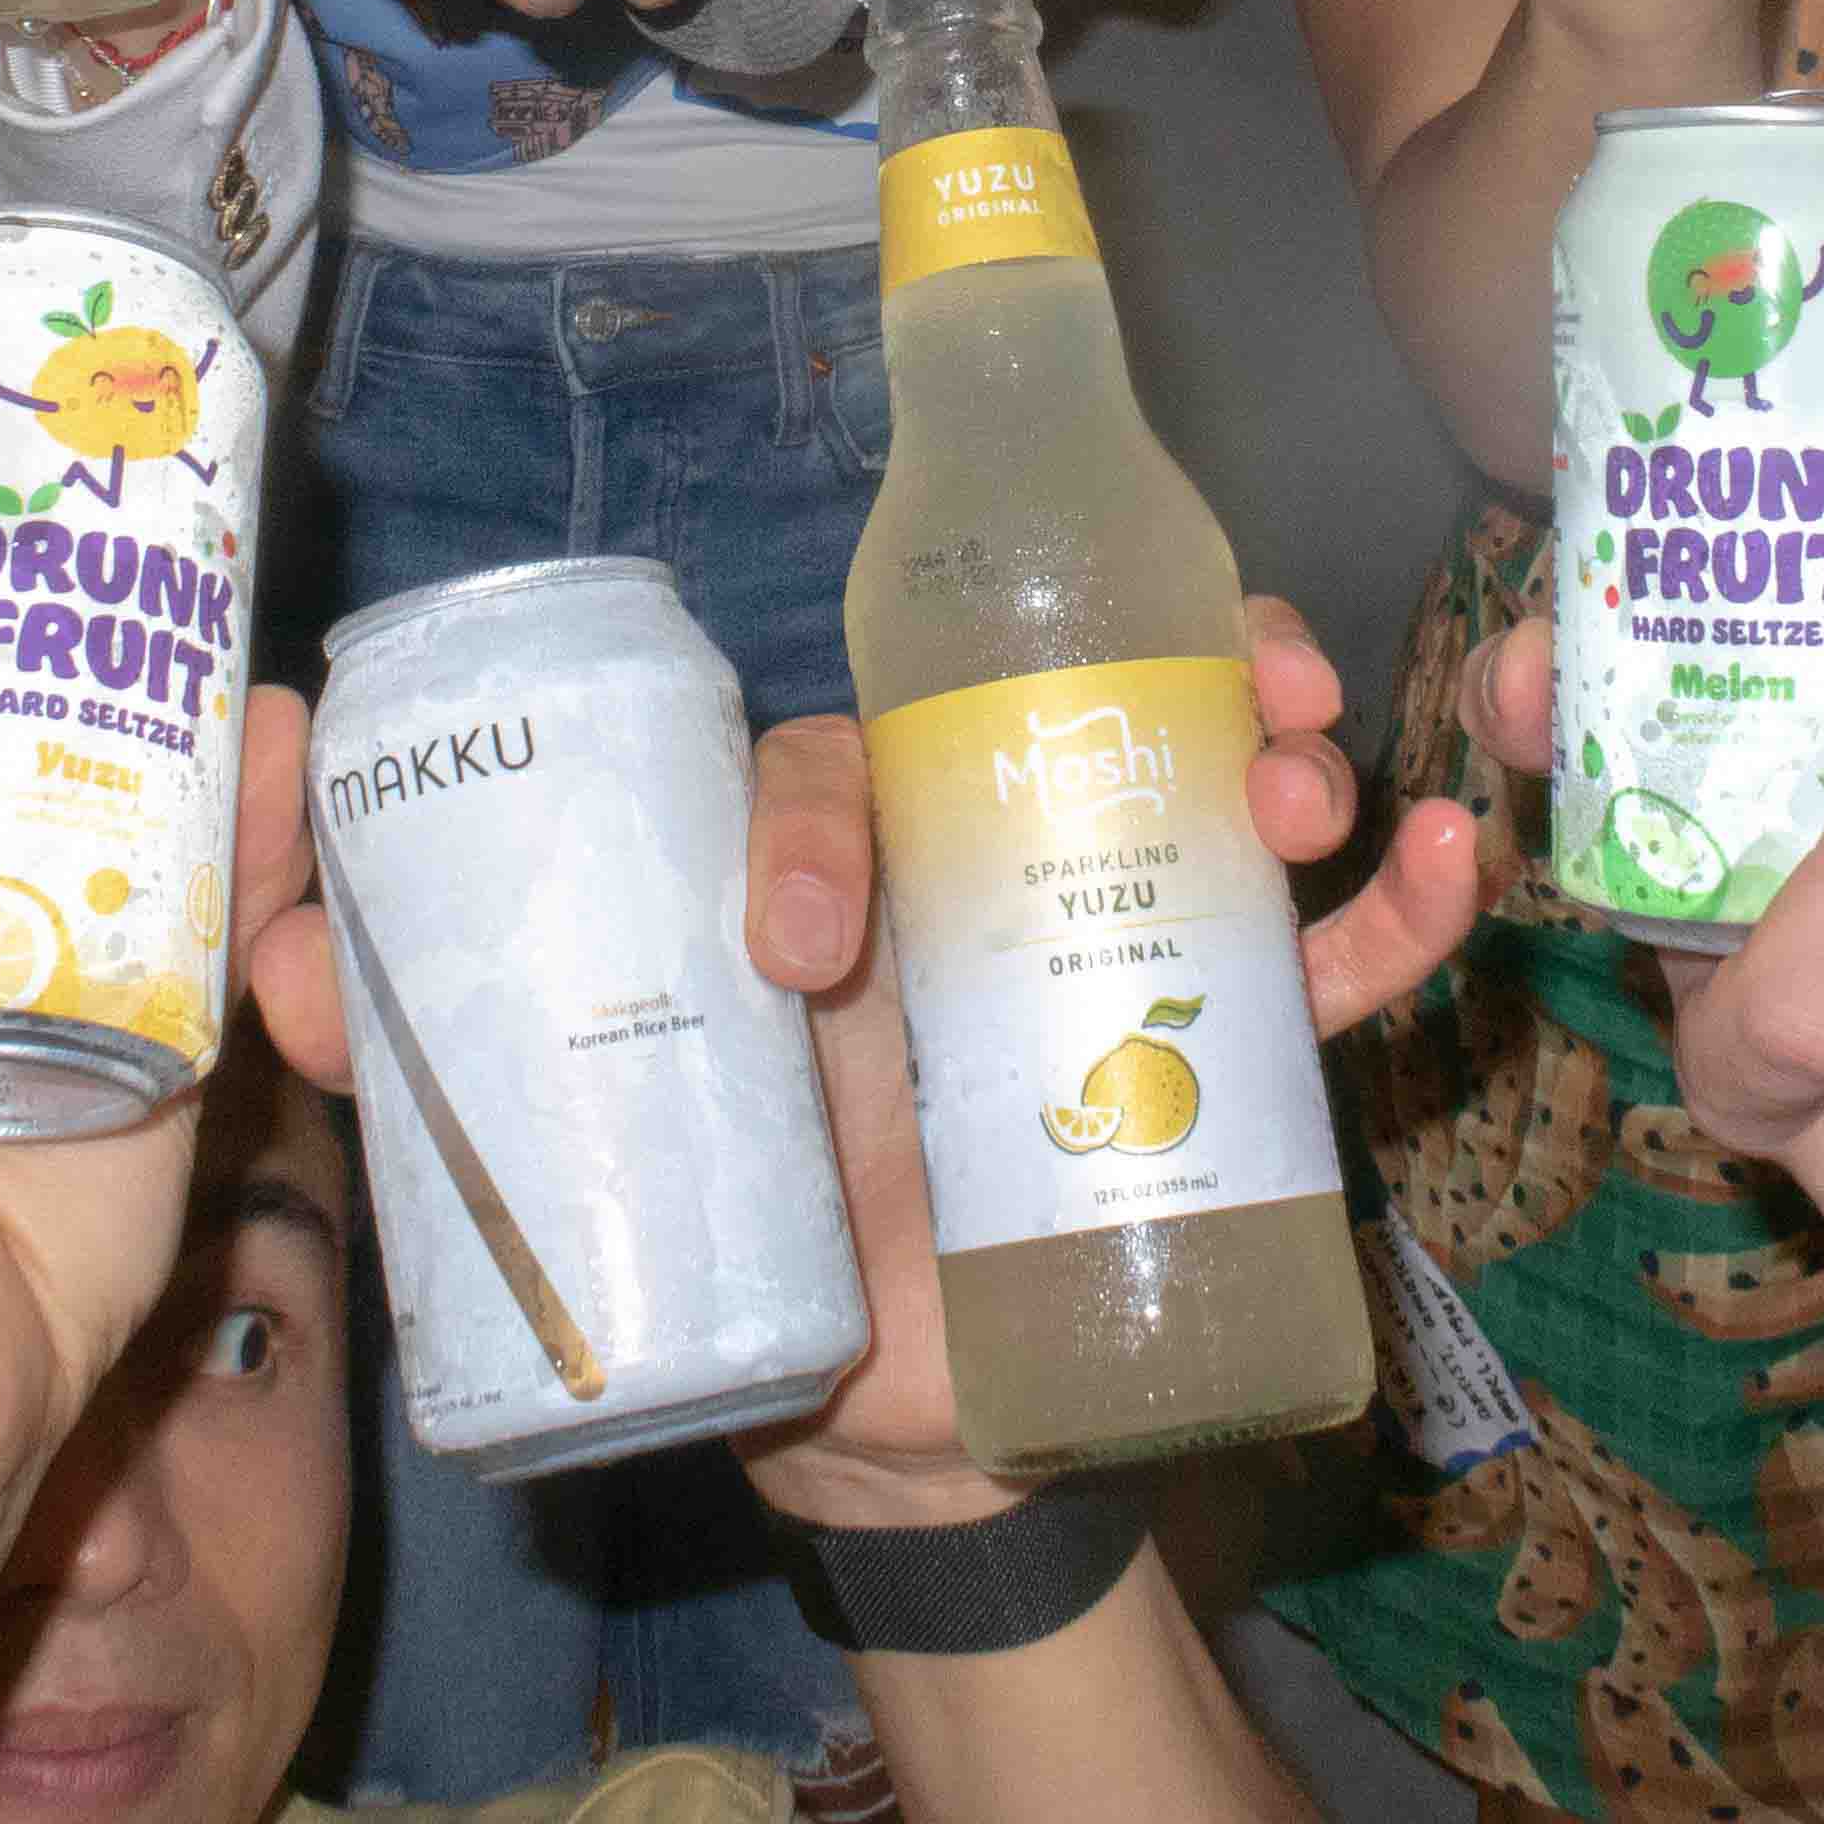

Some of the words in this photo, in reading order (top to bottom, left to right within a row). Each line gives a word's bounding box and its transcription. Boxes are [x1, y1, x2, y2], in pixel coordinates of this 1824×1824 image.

[933, 163, 1036, 202] YUZU
[936, 198, 1044, 227] ORIGINAL
[1631, 615, 1705, 645] HARD
[1669, 661, 1796, 702] Melon
[78, 698, 196, 759] SELTZER
[36, 740, 145, 796] Yuzu
[993, 705, 1177, 819] Moshi
[1023, 843, 1180, 886] SPARKLING
[1057, 879, 1157, 920] YUZU
[1047, 937, 1183, 977] ORIGINAL
[567, 1025, 630, 1052] Korean
[632, 1019, 668, 1040] Rice
[670, 1012, 705, 1032] Beer
